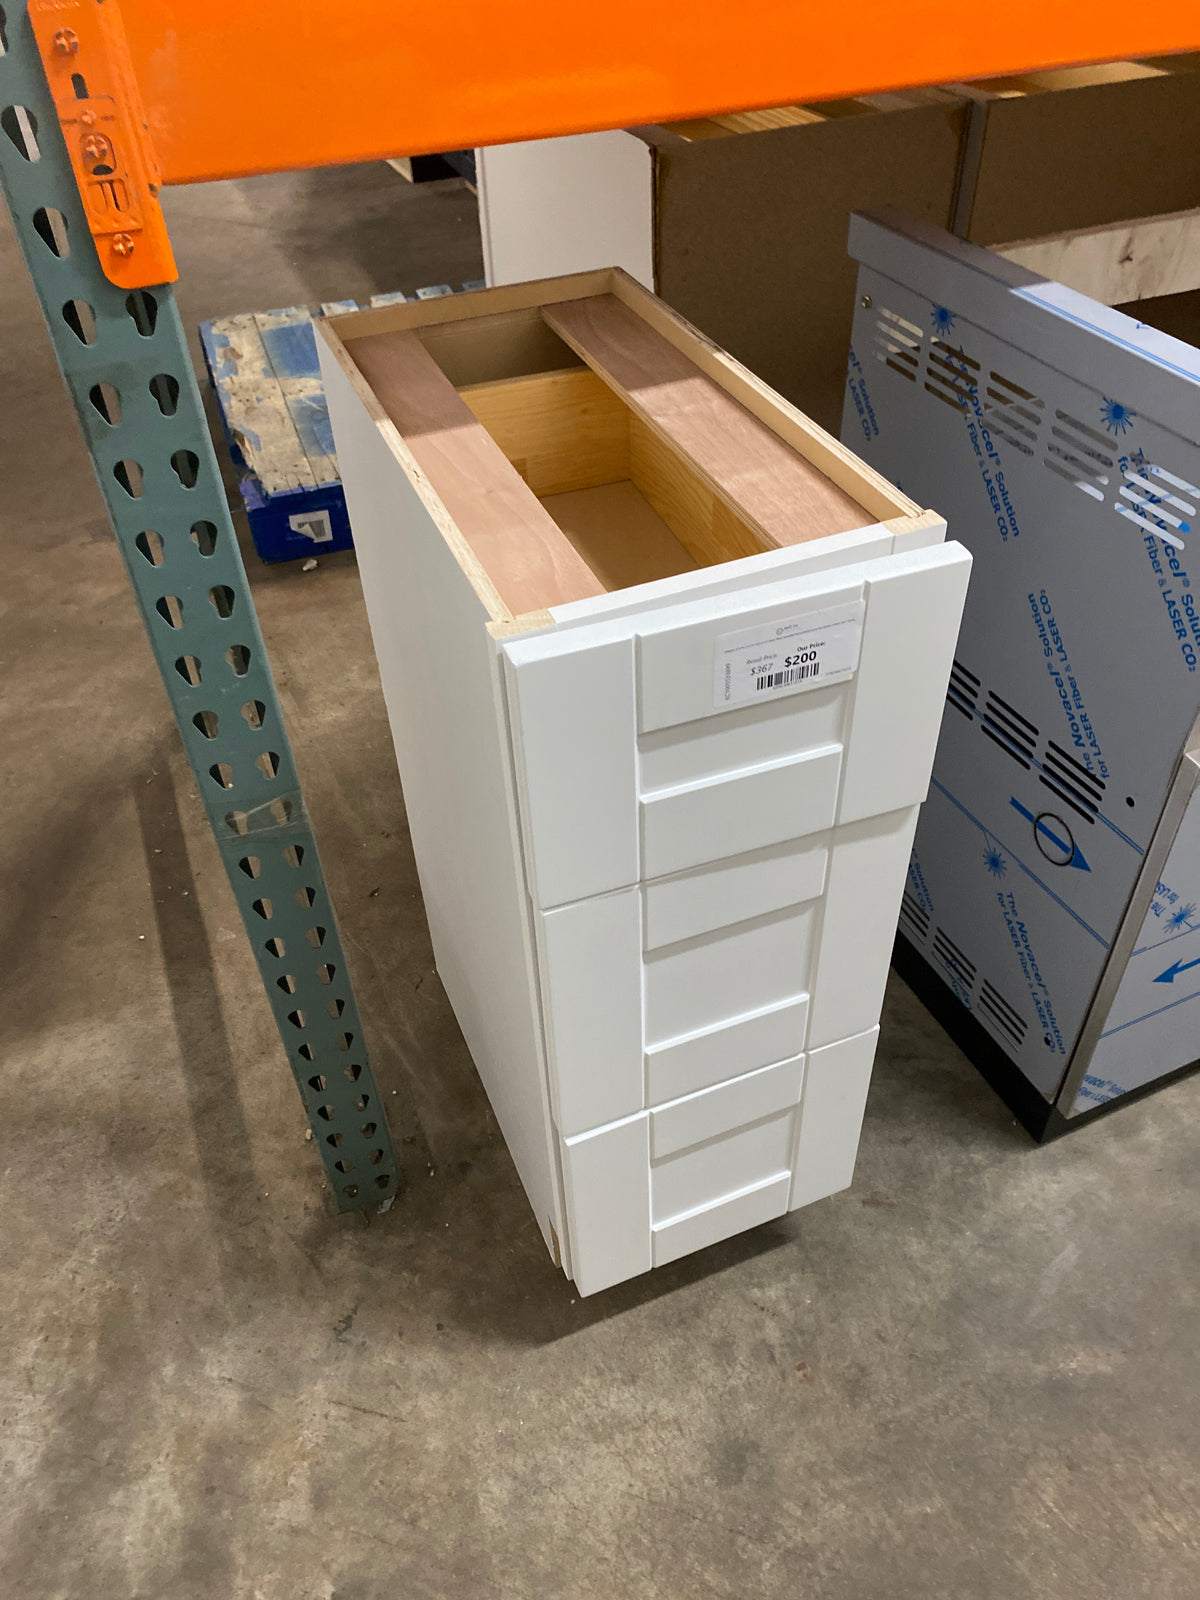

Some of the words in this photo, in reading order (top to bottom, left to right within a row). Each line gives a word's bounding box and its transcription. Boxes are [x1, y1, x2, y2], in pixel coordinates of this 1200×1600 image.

[967, 422, 982, 457] Fiber
[982, 468, 1001, 514] LASER
[995, 471, 1019, 537] Solution
[1143, 536, 1164, 576] Fiber
[1162, 589, 1188, 640] LASER
[1028, 593, 1053, 657] Solution
[1047, 617, 1068, 662] LASER
[750, 662, 774, 676] $367
[784, 650, 817, 668] $200
[1067, 675, 1085, 710] Fiber
[1080, 712, 1102, 756] LASER
[1098, 759, 1110, 779] for
[997, 892, 1007, 909] for
[1003, 911, 1021, 948] LASER
[1031, 992, 1049, 1028] LASER
[1006, 892, 1018, 917] The
[1043, 1000, 1066, 1055] Solution
